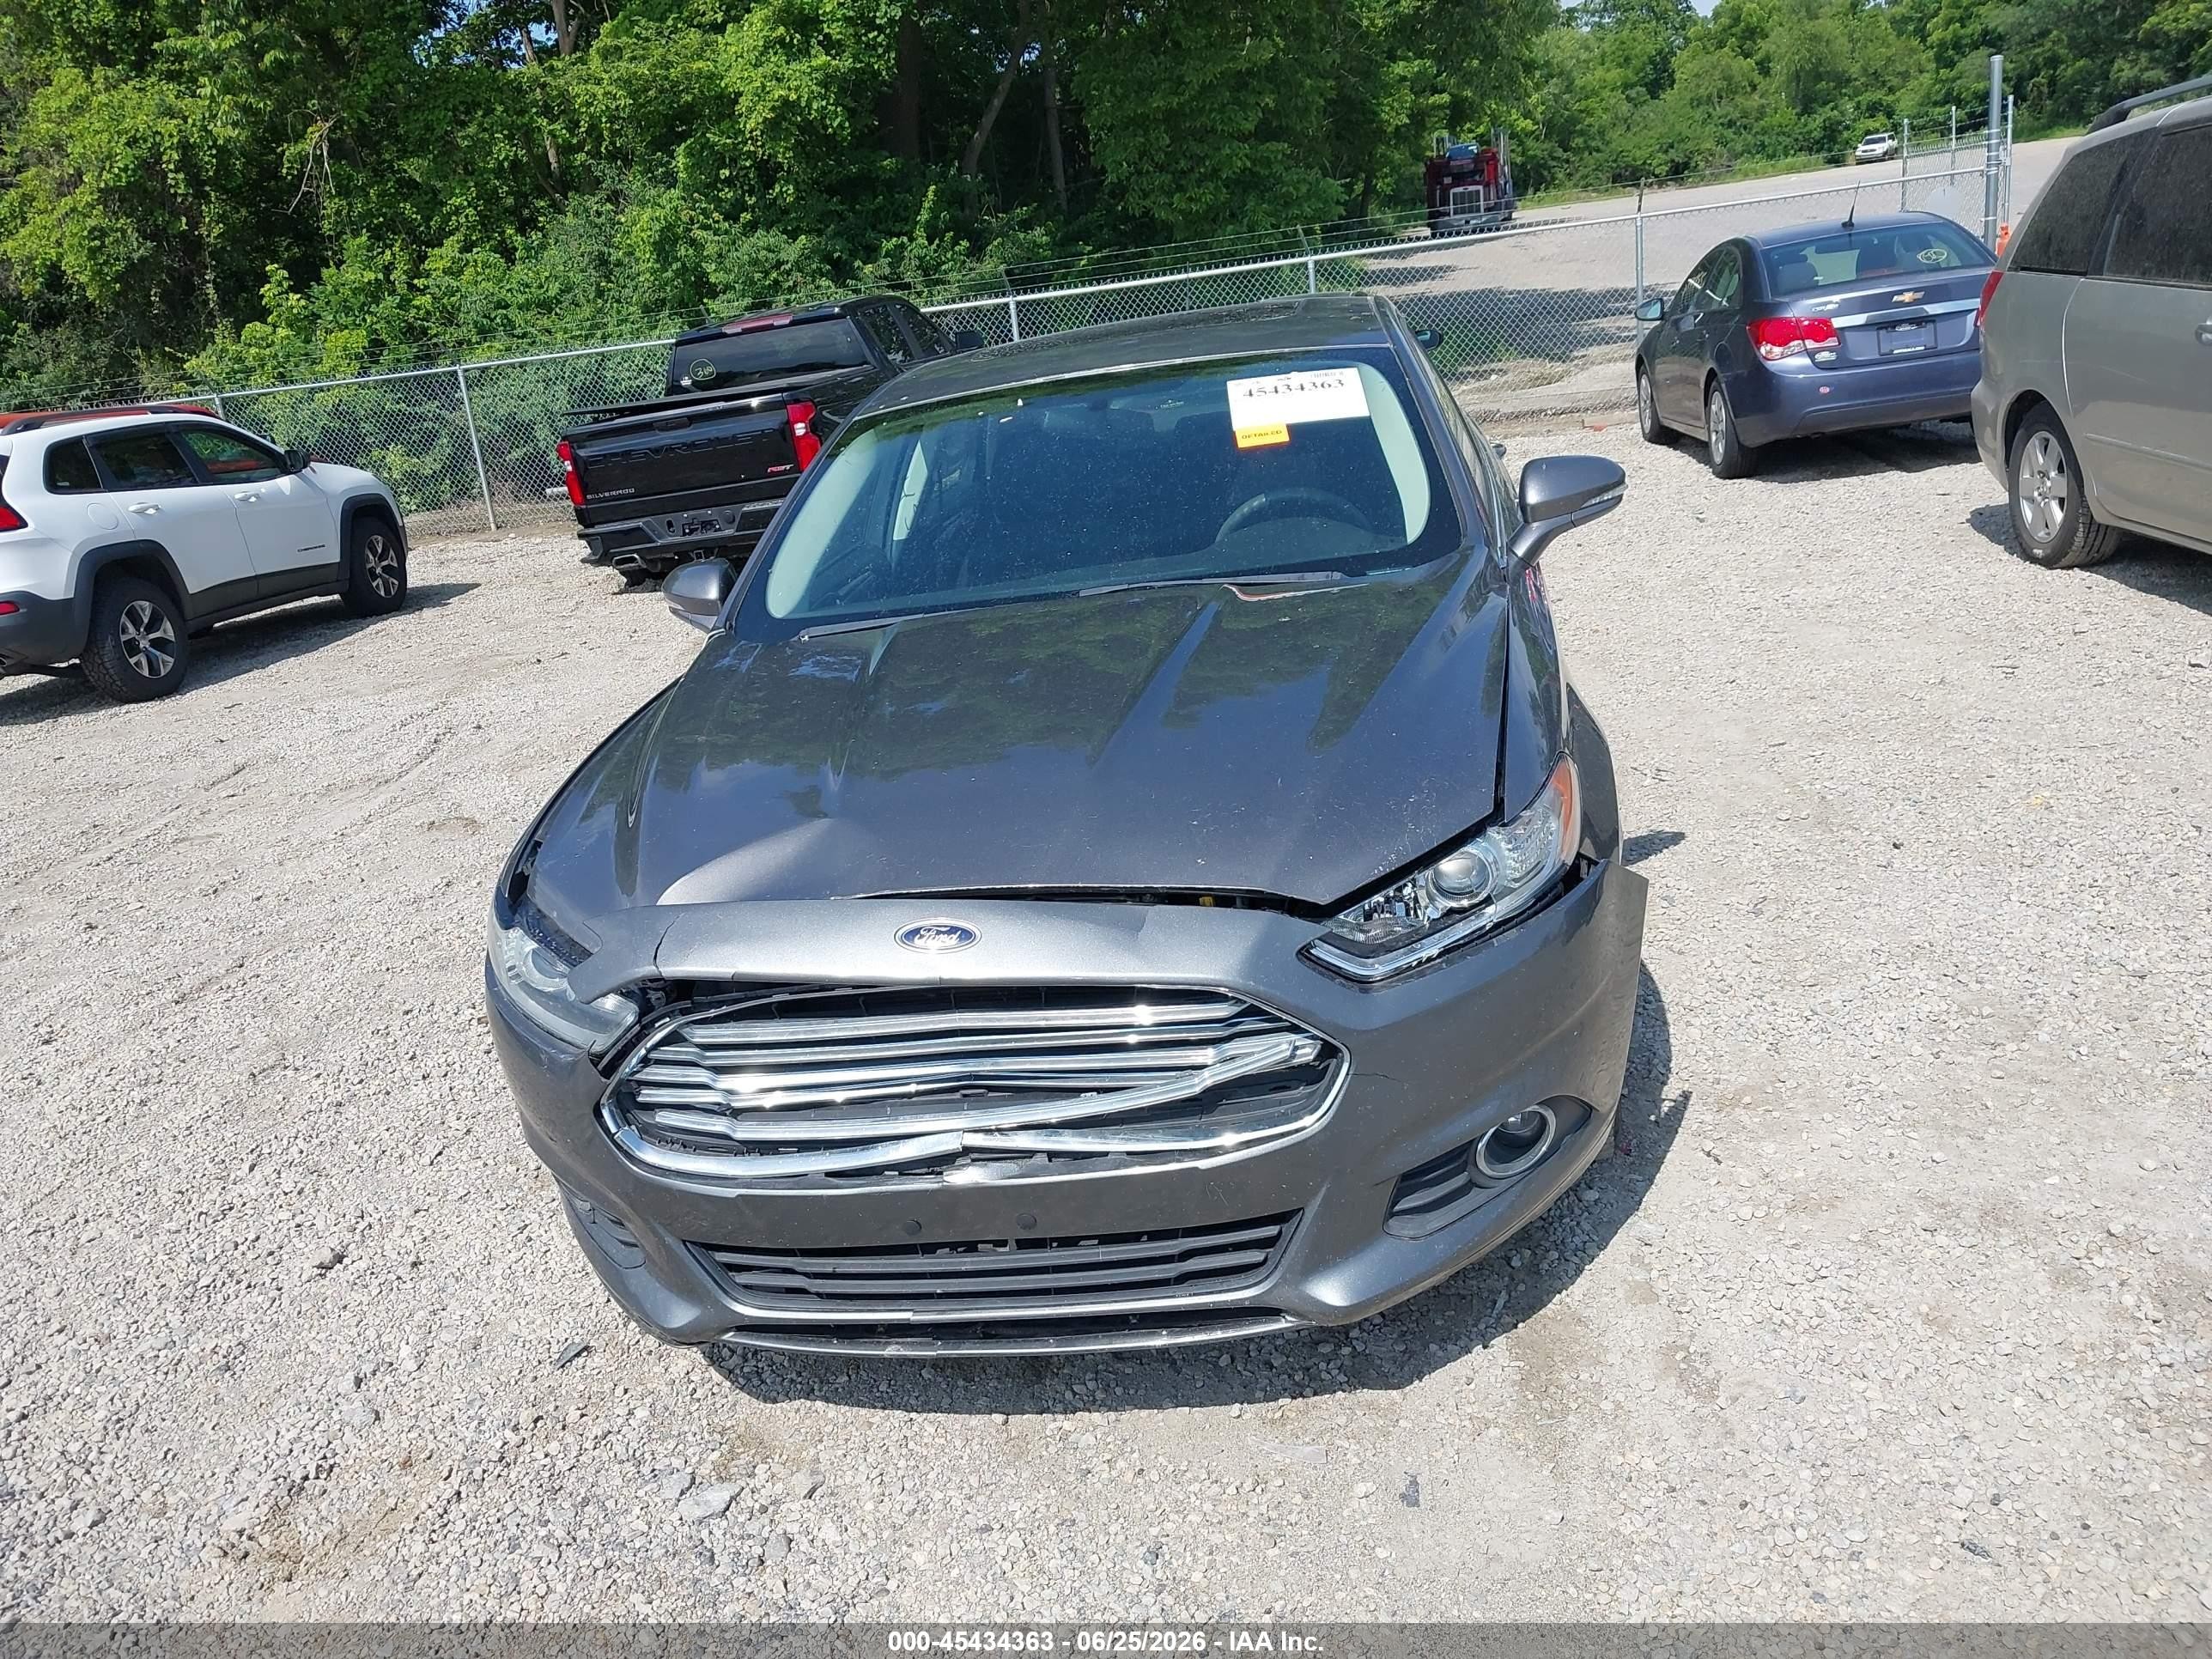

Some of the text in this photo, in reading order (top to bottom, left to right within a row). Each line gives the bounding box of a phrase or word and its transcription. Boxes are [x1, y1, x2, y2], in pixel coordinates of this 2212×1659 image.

[1243, 379, 1345, 398] 45434363
[586, 487, 635, 500] SILVERADO
[914, 926, 962, 945] Ford
